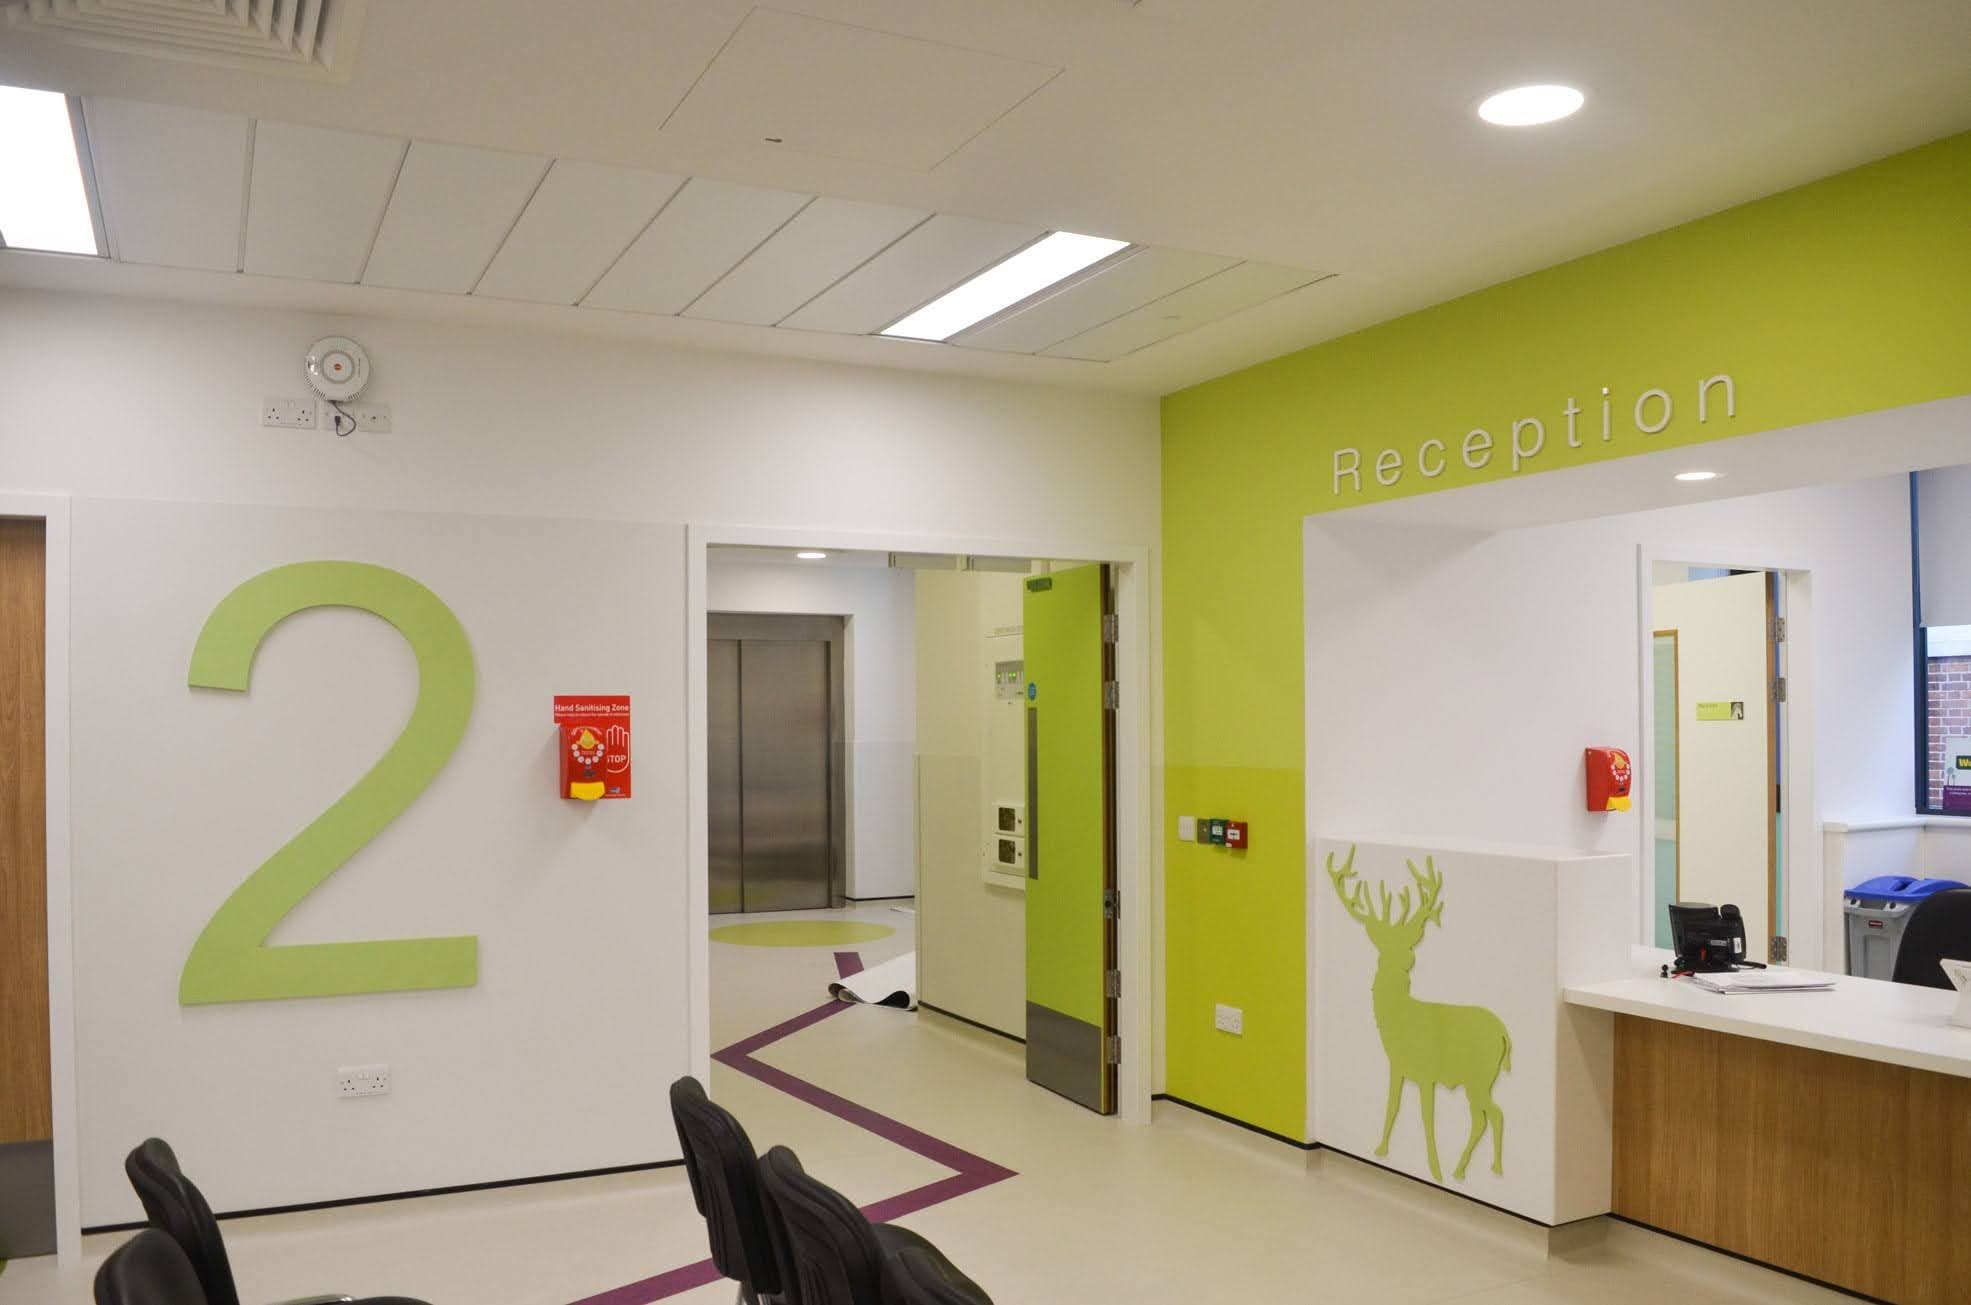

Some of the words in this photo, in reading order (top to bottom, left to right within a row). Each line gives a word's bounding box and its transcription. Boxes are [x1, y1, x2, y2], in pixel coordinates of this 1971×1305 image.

[1332, 373, 1738, 496] Reception
[555, 704, 574, 712] Hand
[575, 704, 610, 713] Sanitising
[612, 704, 629, 712] Zone
[178, 560, 478, 1007] 2
